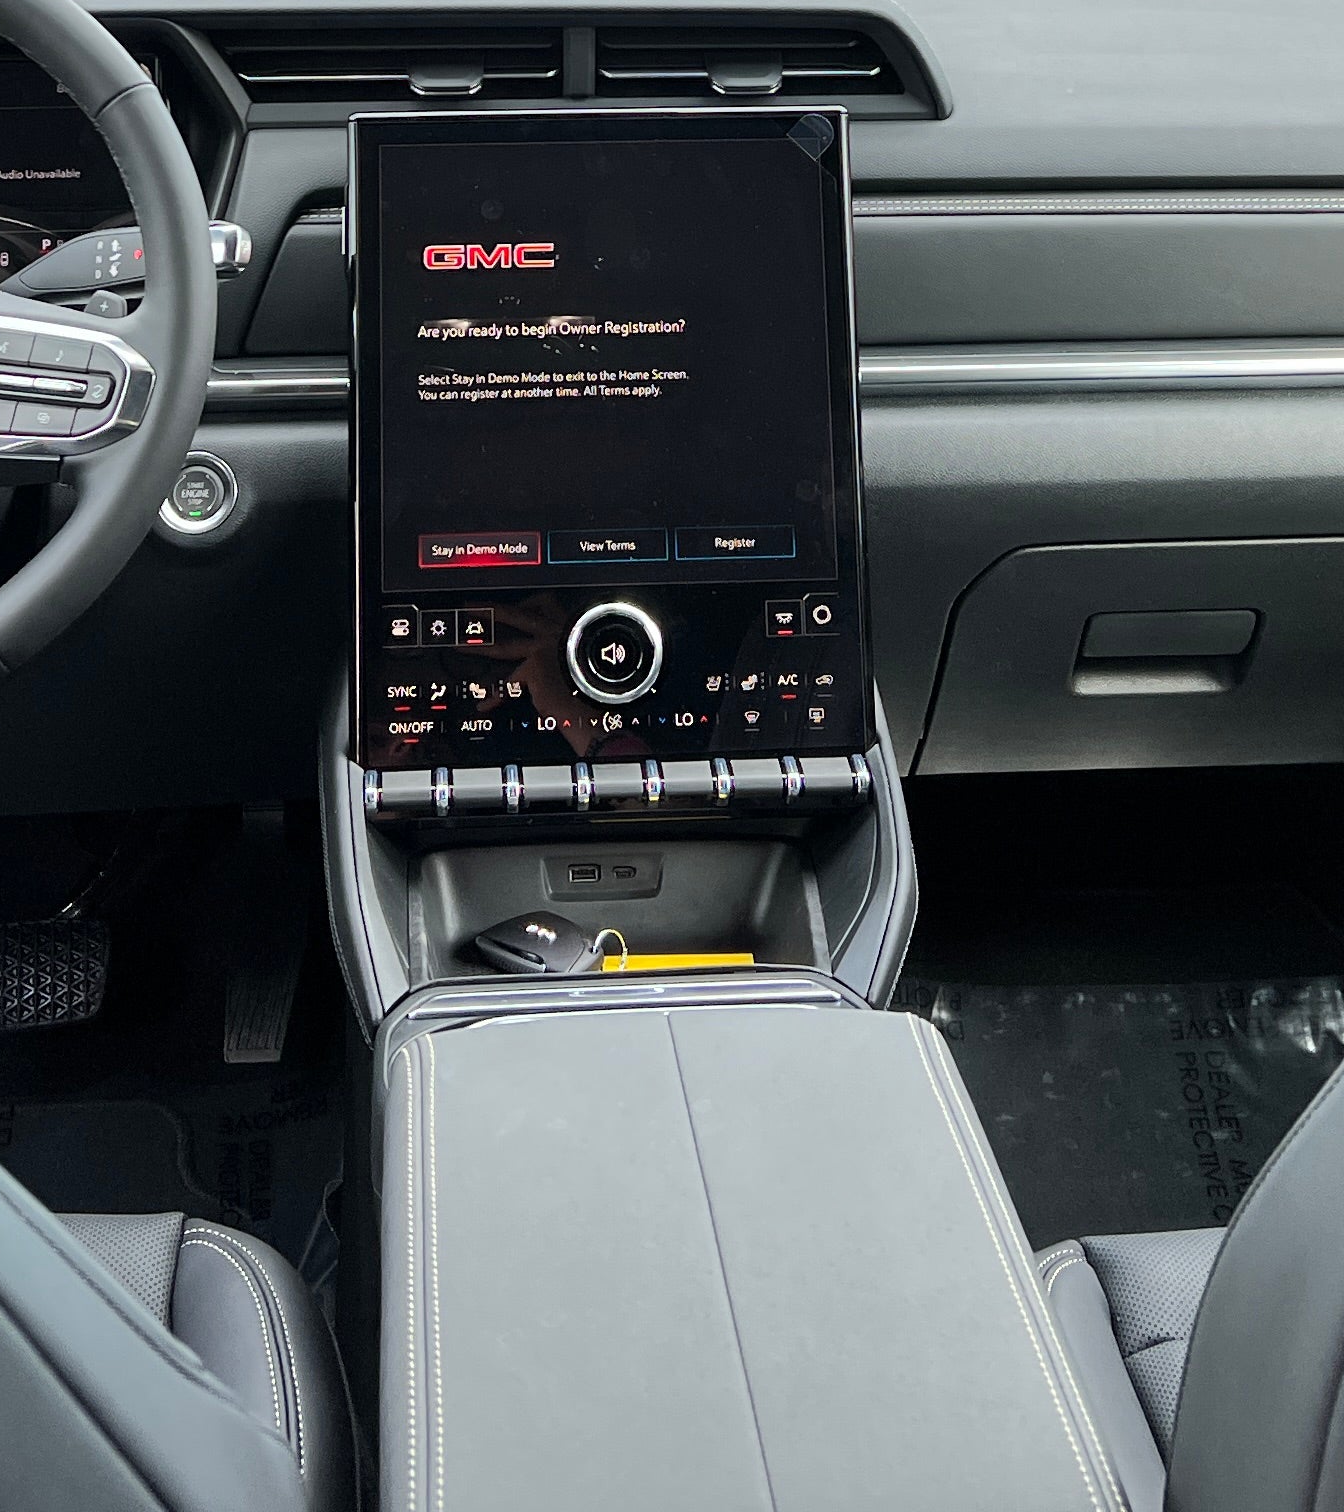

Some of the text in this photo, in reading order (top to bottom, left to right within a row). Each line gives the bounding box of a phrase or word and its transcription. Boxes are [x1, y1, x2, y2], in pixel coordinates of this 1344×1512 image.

[25, 169, 81, 180] Unavailable
[42, 239, 52, 250] P
[423, 243, 555, 269] GMC
[418, 319, 686, 340] Are you ready to begin Owner Registration?
[418, 369, 690, 386] Select Stay in Demo Mode to exit to the Home Screen.
[418, 384, 663, 402] You can register at another time. All Terms apply.
[181, 489, 209, 498] ENGINE
[432, 542, 528, 556] Stay in Demo Mode
[580, 540, 636, 552] View Terms
[715, 537, 756, 549] Register
[777, 673, 799, 686] A/C
[388, 685, 417, 698] SYNC
[461, 719, 493, 732] AUTO
[537, 716, 557, 731] LO
[674, 712, 694, 727] LO
[389, 721, 434, 734] ON/OFF
[1175, 1050, 1226, 1198] PROTECTIVE
